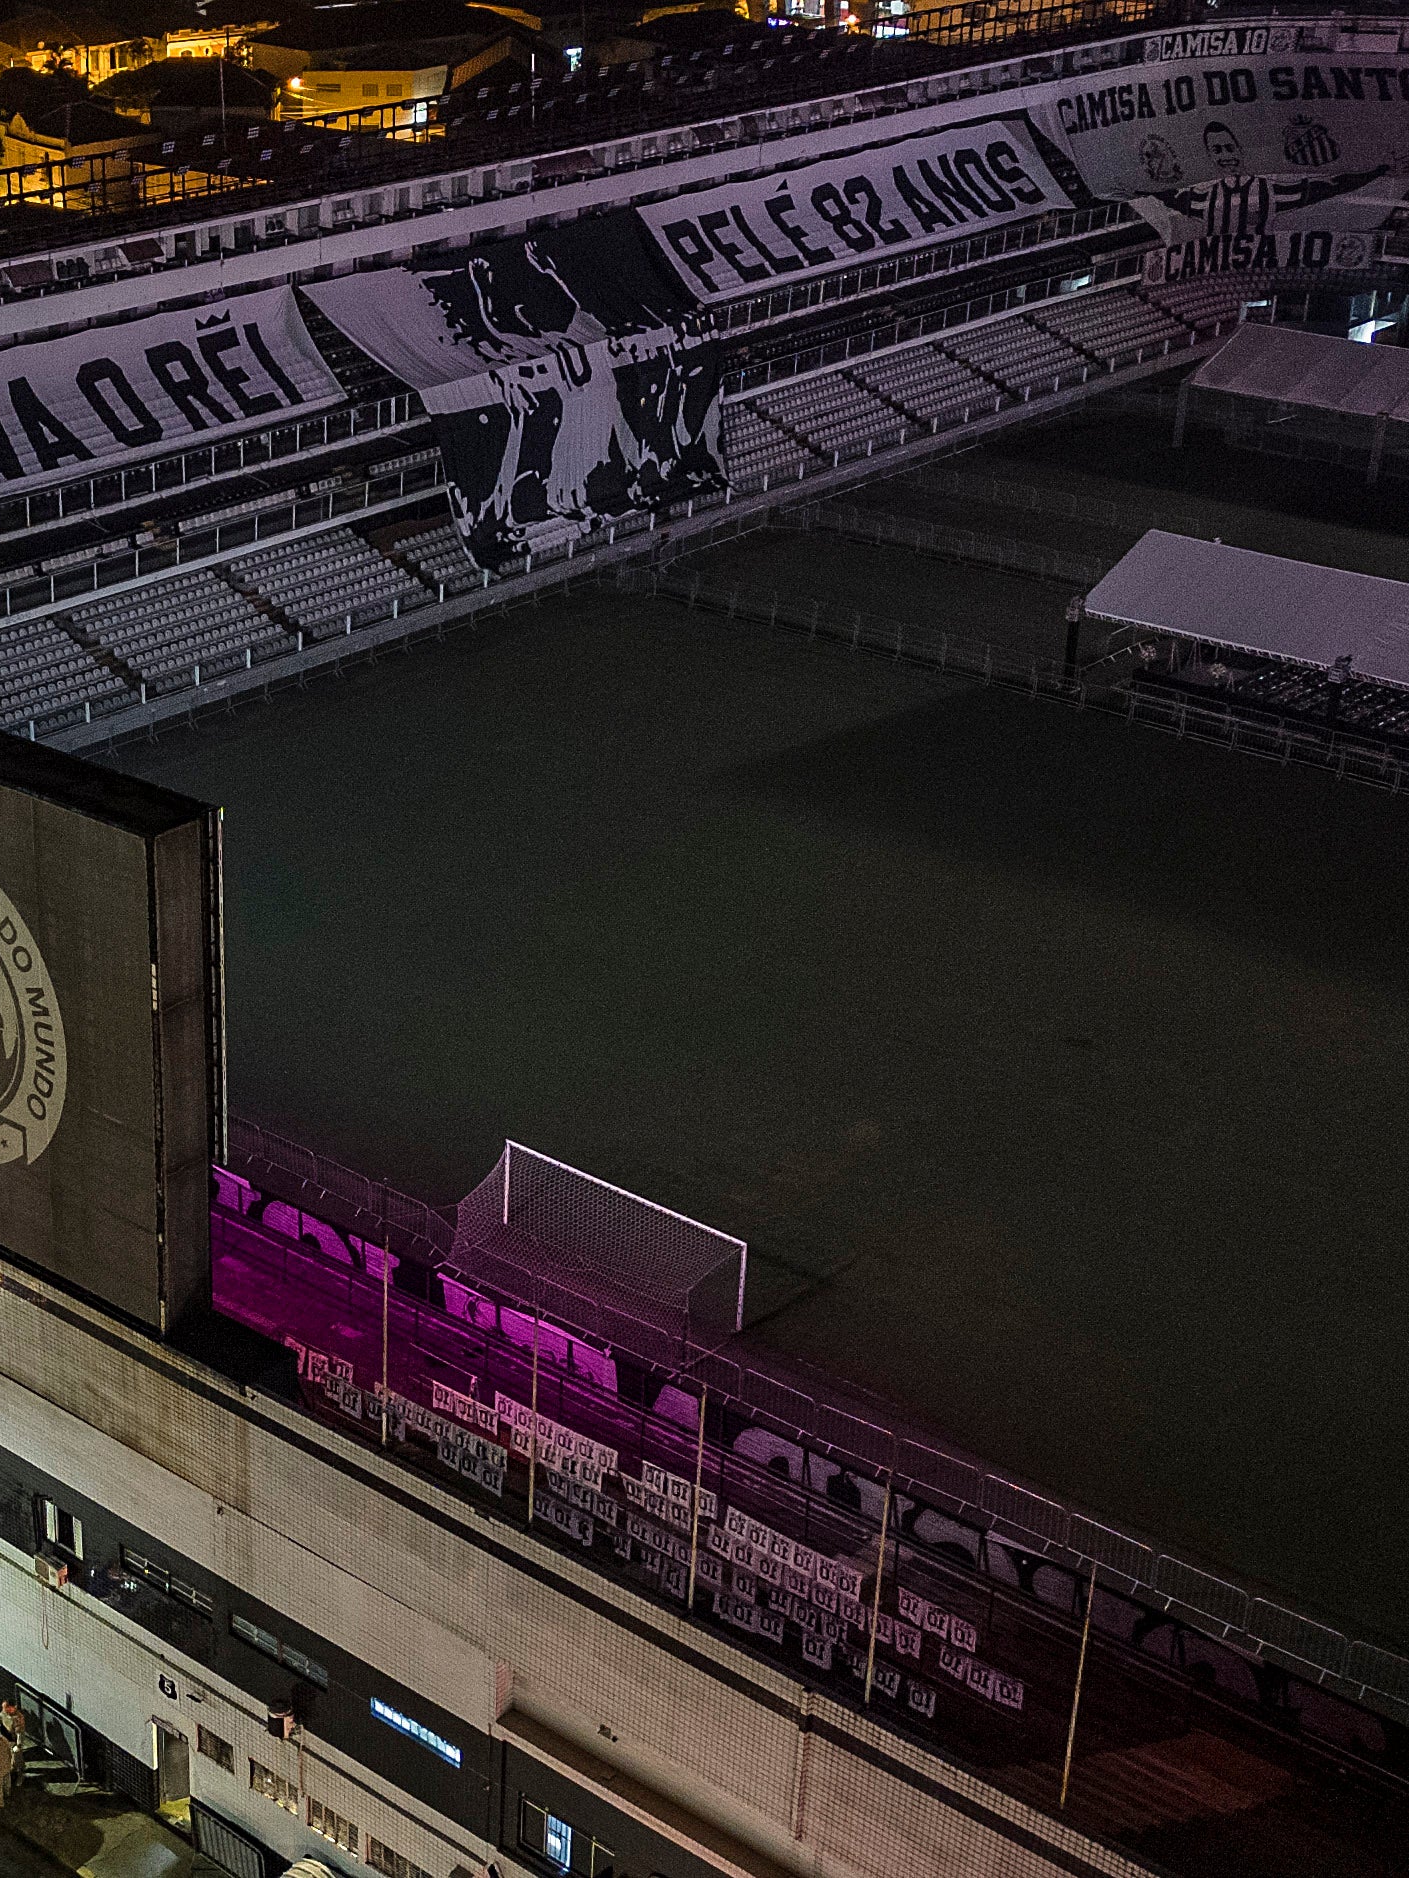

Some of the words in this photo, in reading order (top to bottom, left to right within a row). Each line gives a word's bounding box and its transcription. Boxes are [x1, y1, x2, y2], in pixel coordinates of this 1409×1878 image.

[1162, 30, 1238, 59] CAMISA
[1243, 29, 1268, 54] 10
[1058, 82, 1156, 135] CAMISA
[1162, 76, 1196, 115] 10
[1202, 69, 1257, 105] DO
[662, 180, 835, 292] PELÉ
[810, 175, 911, 251] 82
[892, 140, 1047, 234] ANOS
[1165, 233, 1279, 281] CAMISA
[1290, 231, 1332, 268] 10
[76, 357, 164, 446] O
[26, 987, 56, 1121] MUNDO
